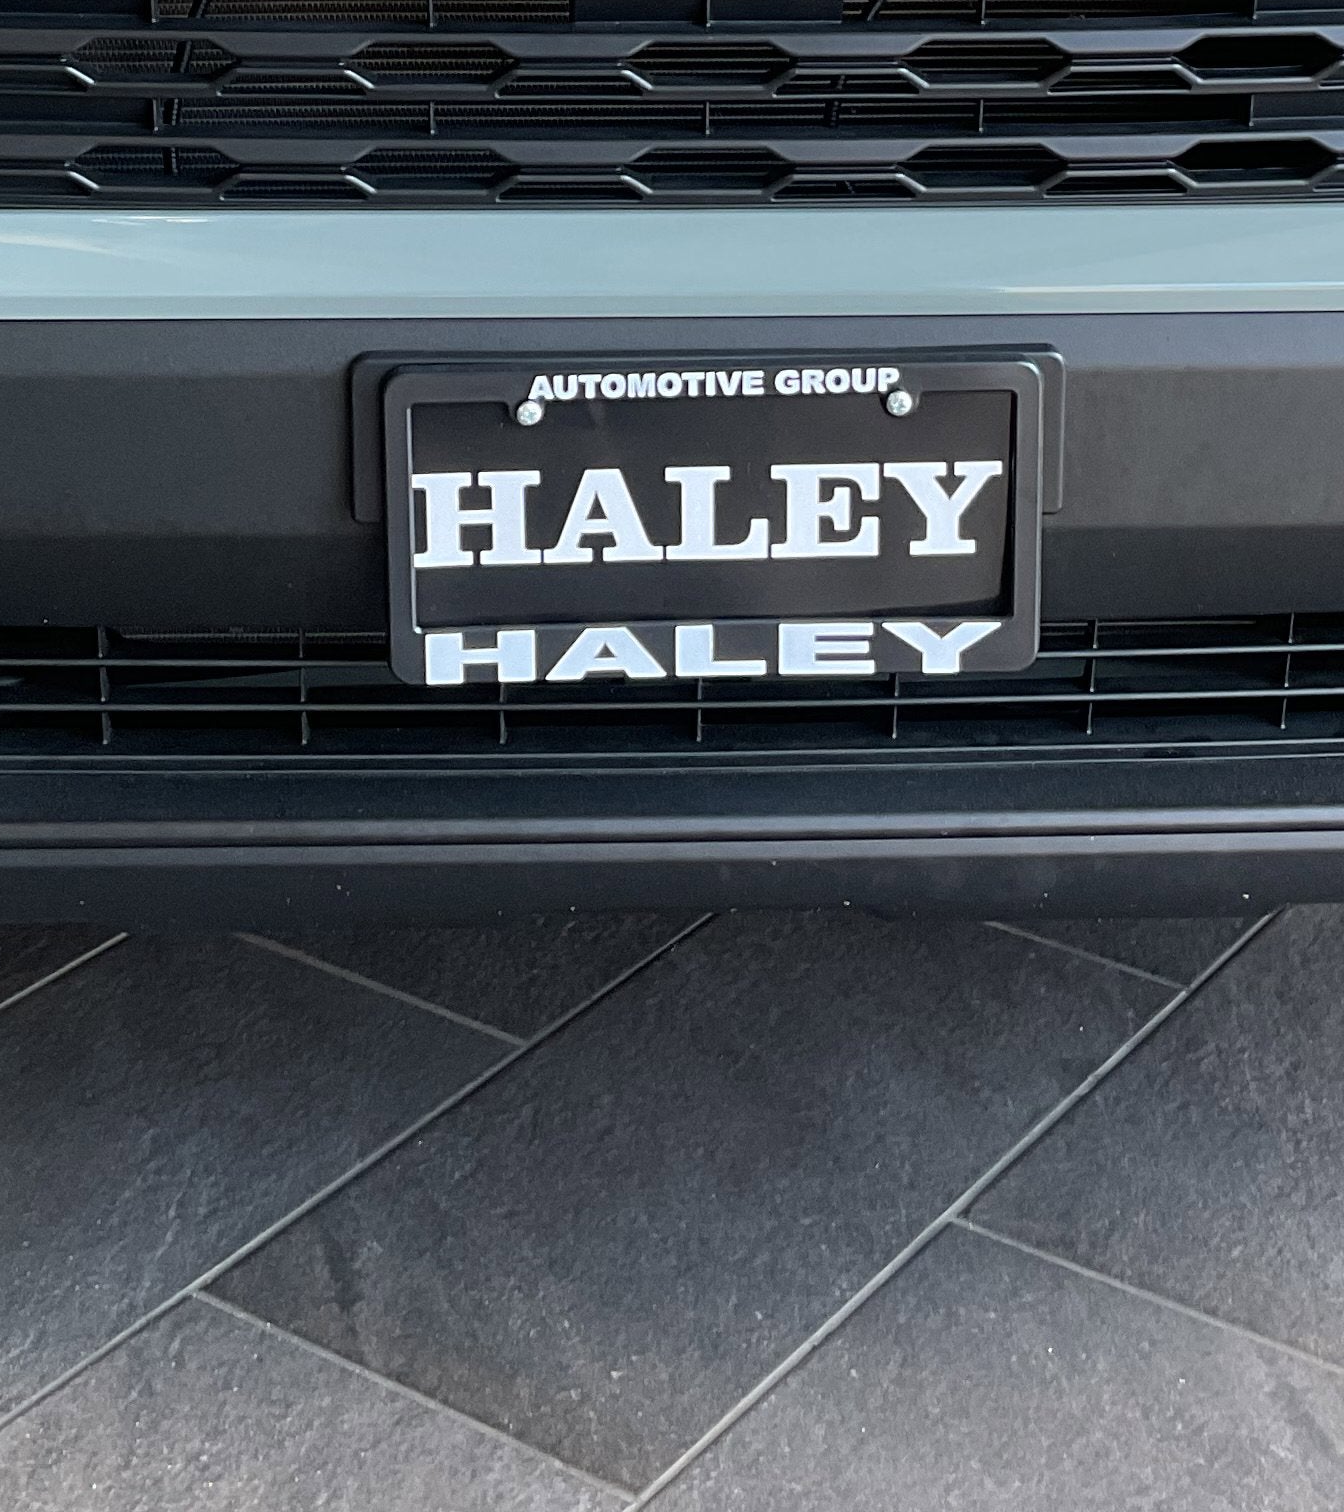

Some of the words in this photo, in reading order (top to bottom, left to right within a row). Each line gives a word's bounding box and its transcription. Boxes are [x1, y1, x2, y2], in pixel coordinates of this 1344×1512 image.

[528, 369, 766, 402] AUTOMOTIVE
[773, 366, 900, 395] GROUP
[411, 459, 1003, 569] HALEY
[424, 620, 1002, 686] HALEY
